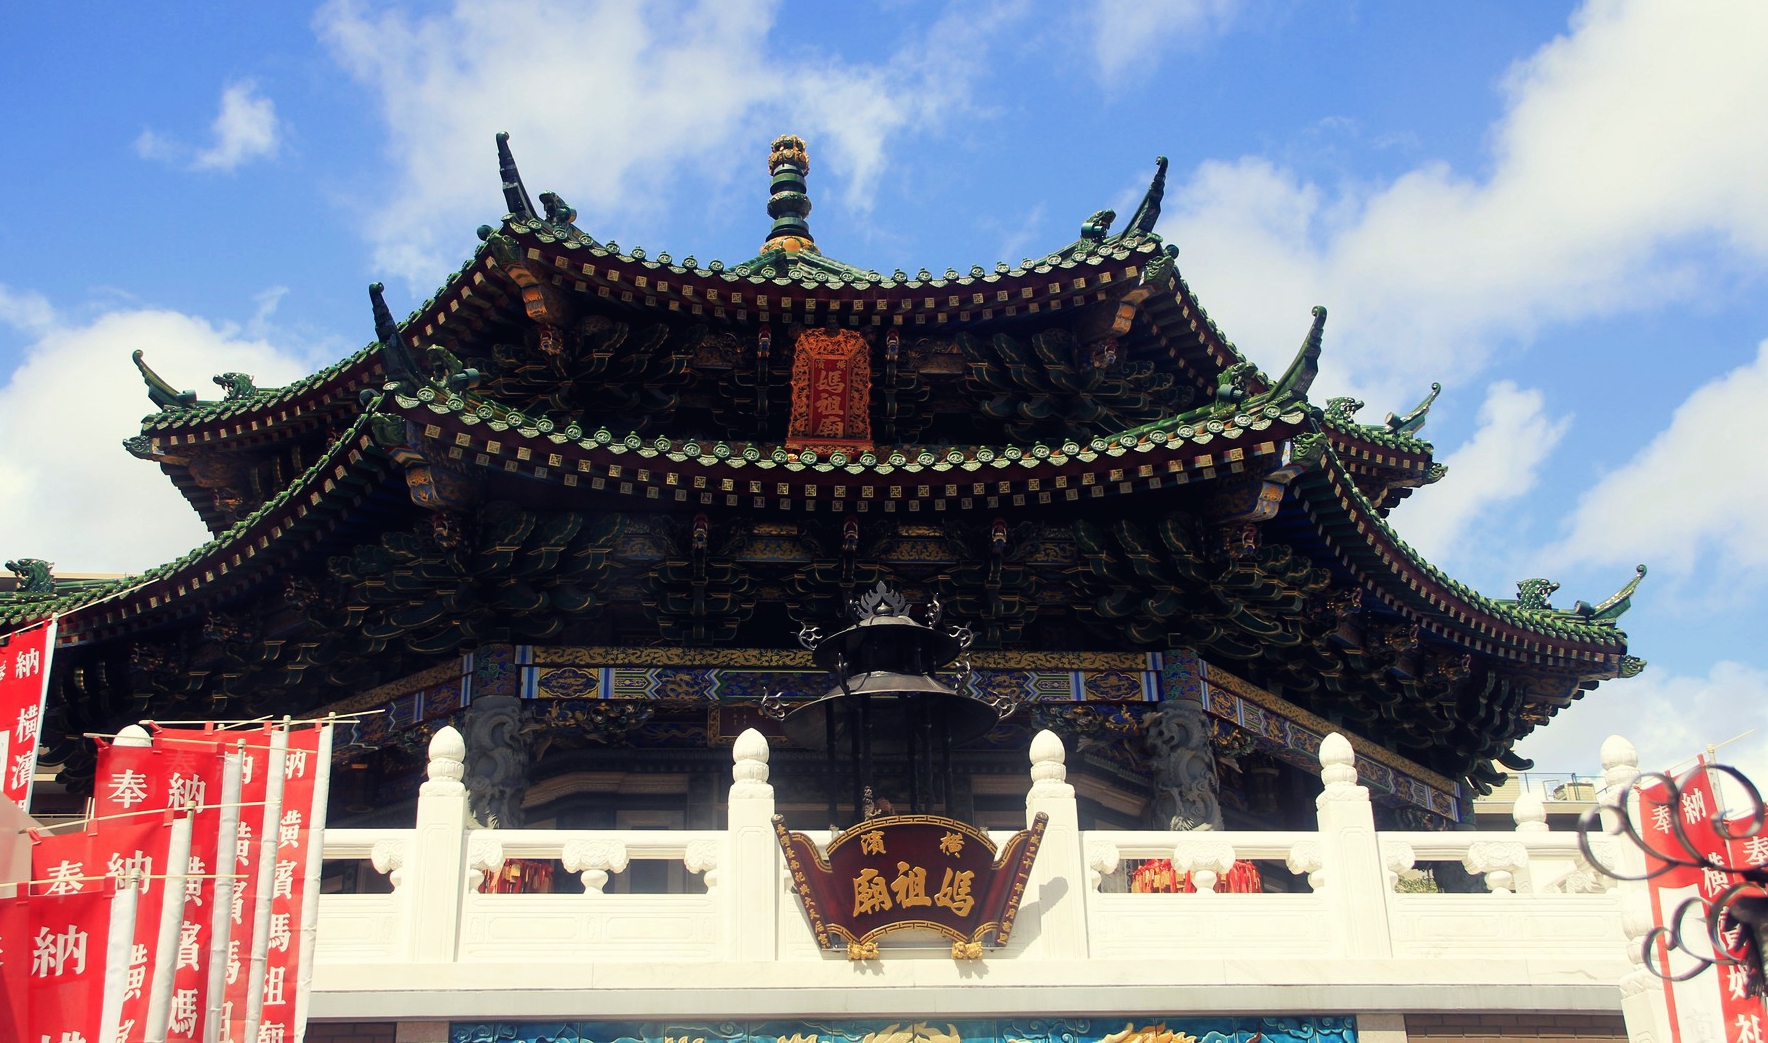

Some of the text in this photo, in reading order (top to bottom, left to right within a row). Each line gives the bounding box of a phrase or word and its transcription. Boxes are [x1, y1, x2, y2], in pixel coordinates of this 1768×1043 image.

[813, 370, 845, 438] 媽祖廟
[11, 703, 38, 812] 横濱
[107, 768, 206, 814] 奉納
[1651, 787, 1707, 835] 奉納
[853, 860, 975, 918] 媽祖廟
